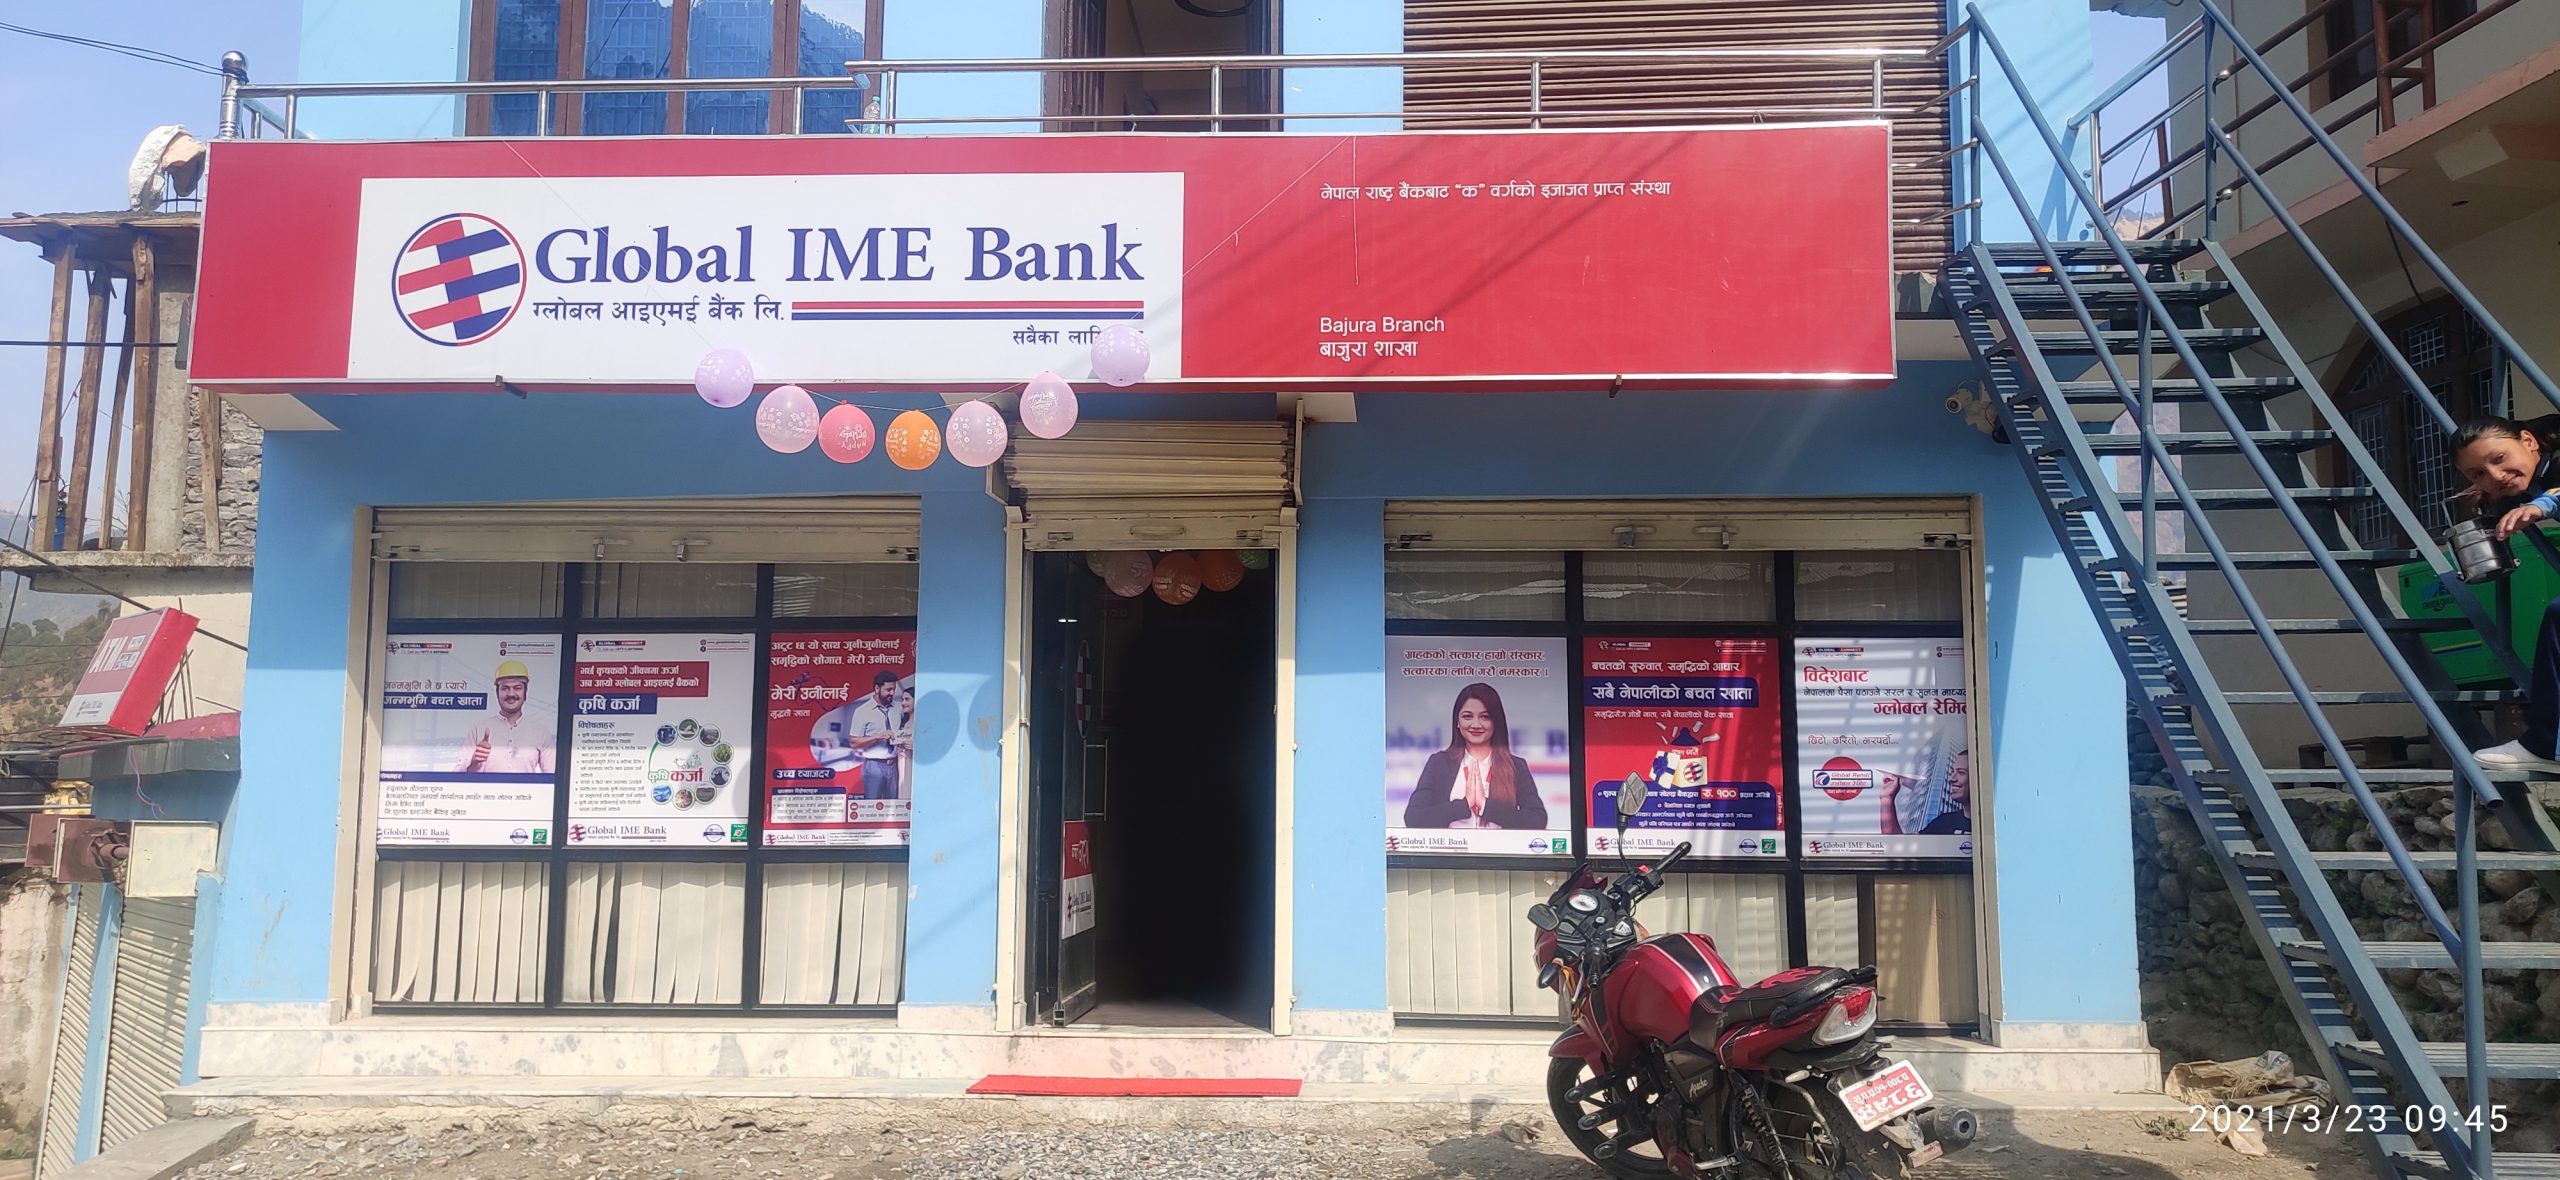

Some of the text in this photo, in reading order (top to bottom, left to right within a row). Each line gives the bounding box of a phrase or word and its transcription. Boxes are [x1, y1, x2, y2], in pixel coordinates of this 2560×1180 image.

[1320, 183, 1361, 200] नेपाल
[1399, 181, 1450, 199] बैंकबाट
[1490, 180, 1536, 197] वर्गको
[1541, 183, 1589, 198] इजाजत
[1593, 182, 1625, 197] प्राप्त
[1630, 180, 1671, 195] संस्था
[535, 223, 1144, 284] Global IME Bank
[533, 293, 784, 326] ग्लोबल आइएमई बैंक लि.
[1320, 315, 1445, 337] Bajura Branch
[1013, 324, 1059, 346] सबैका
[1319, 340, 1418, 361] बाजुरा शाखा
[1451, 666, 1474, 676] लागि
[1592, 660, 1625, 671] बचतको
[1804, 666, 1869, 683] विदेशबाट
[770, 683, 850, 701] मेरी उनीलाई
[1592, 682, 1752, 700] सबै नेपालीको बचत खाता
[1803, 687, 1835, 697] नेपालमा
[1856, 686, 1881, 697] पठाउने
[457, 696, 483, 706] खाता
[579, 694, 640, 715] कृषि कर्जा
[1873, 699, 1928, 716] ग्लोबल
[670, 768, 704, 782] कर्जा
[384, 828, 449, 837] Global IME Bank
[588, 825, 667, 835] Global IME Bank
[1401, 837, 1468, 846] Global IME Bank
[1657, 838, 1676, 846] Bank
[1823, 841, 1846, 849] Global
[1866, 841, 1884, 849] Bank
